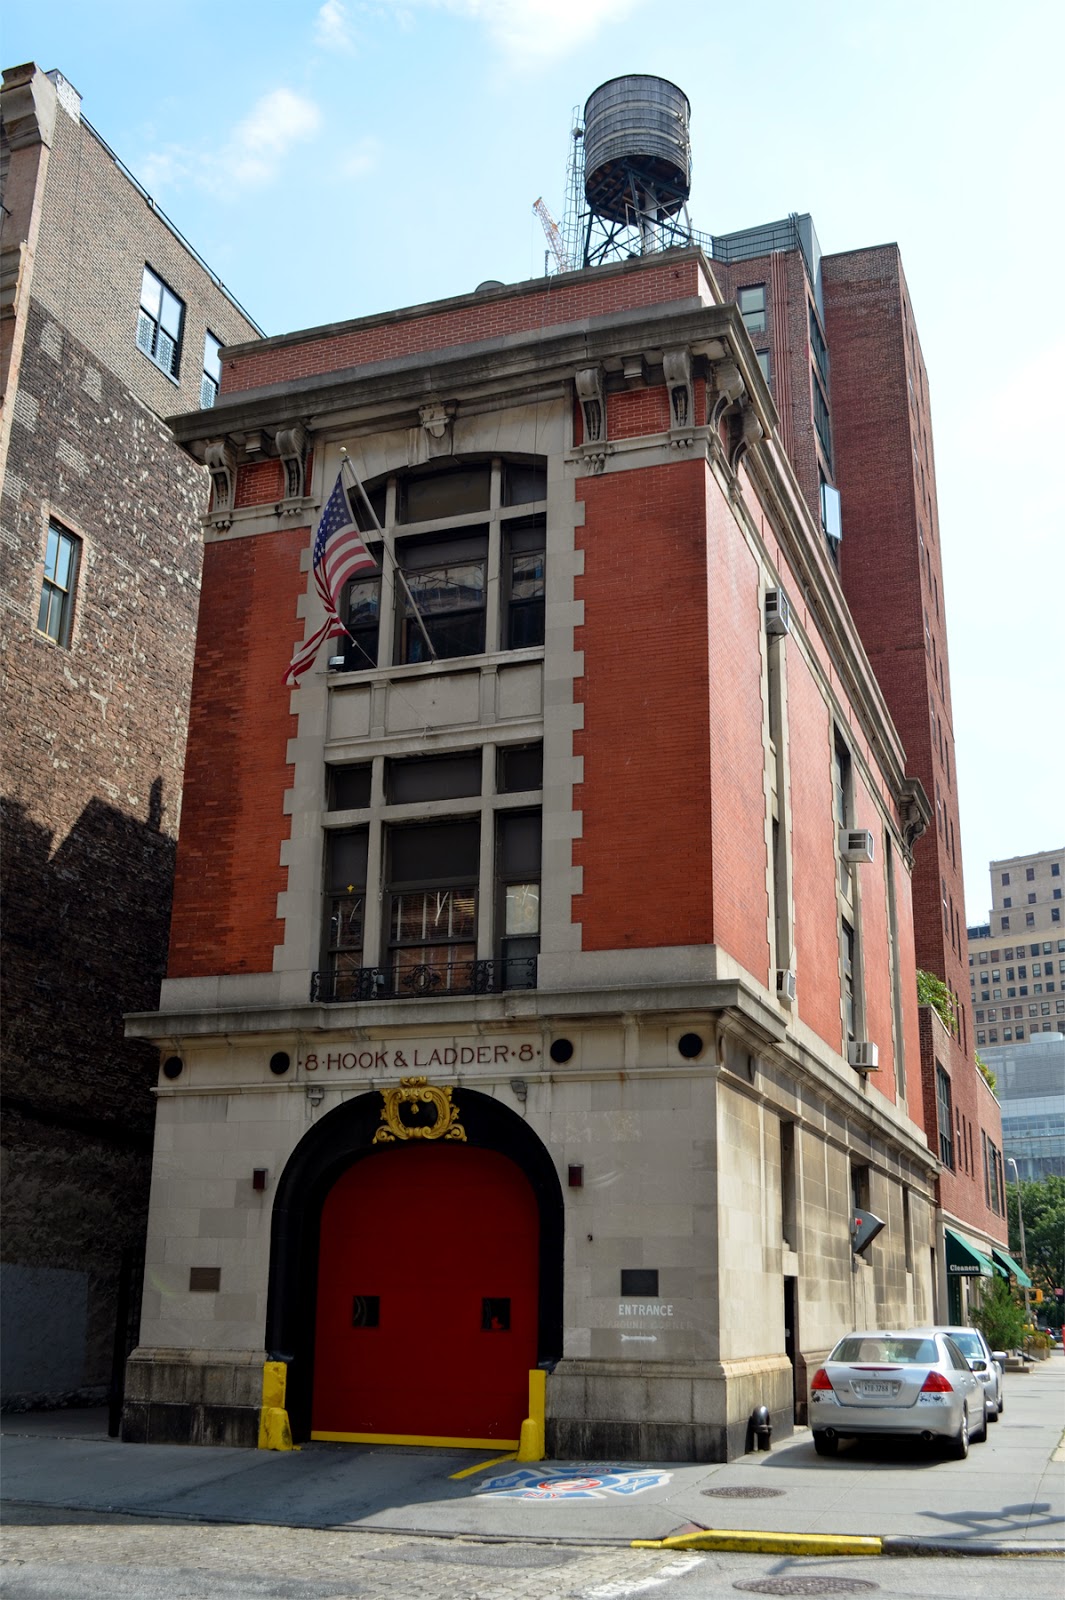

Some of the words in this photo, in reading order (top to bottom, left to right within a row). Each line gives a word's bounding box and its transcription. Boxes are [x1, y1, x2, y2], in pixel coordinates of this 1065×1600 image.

[393, 1050, 408, 1068] &
[949, 1264, 979, 1272] Cleaners
[618, 1304, 674, 1316] ENTRANCE
[522, 1490, 565, 1499] NY
